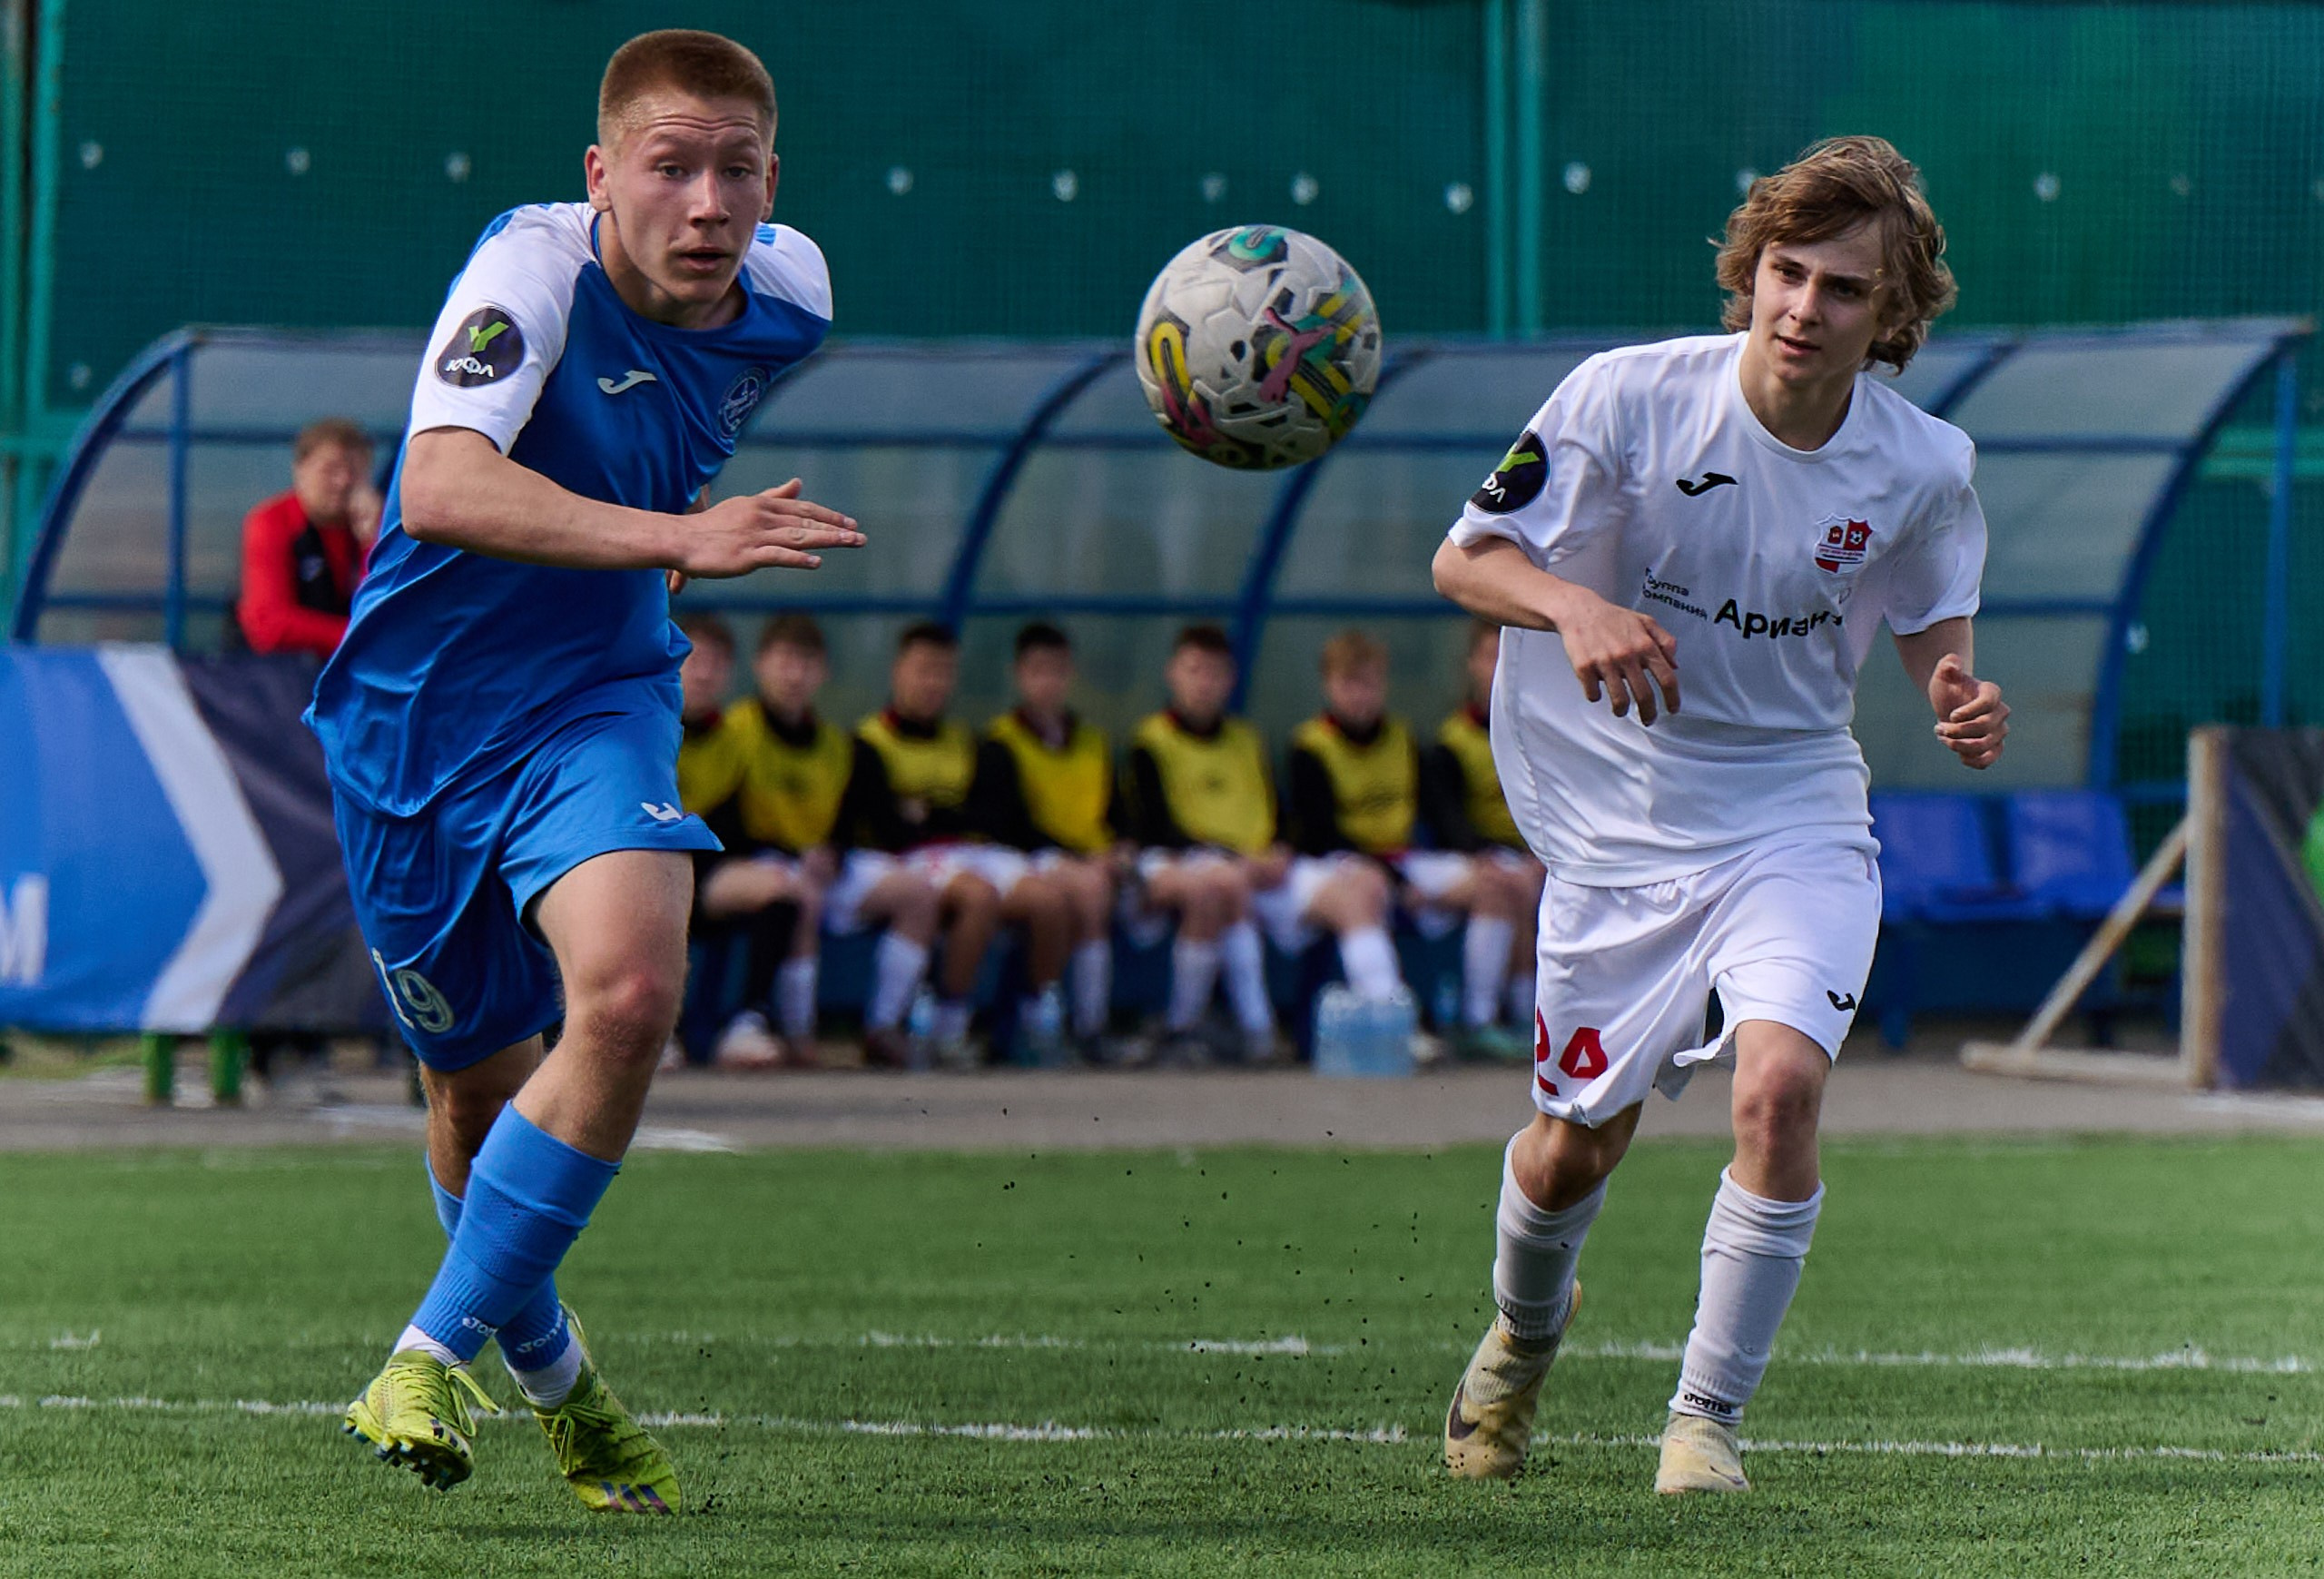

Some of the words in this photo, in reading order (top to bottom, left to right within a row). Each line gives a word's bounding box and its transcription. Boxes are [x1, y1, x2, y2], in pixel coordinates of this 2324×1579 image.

[444, 356, 495, 378] ЮФЛ
[1642, 582, 1709, 621] омпания
[371, 946, 454, 1033] 19
